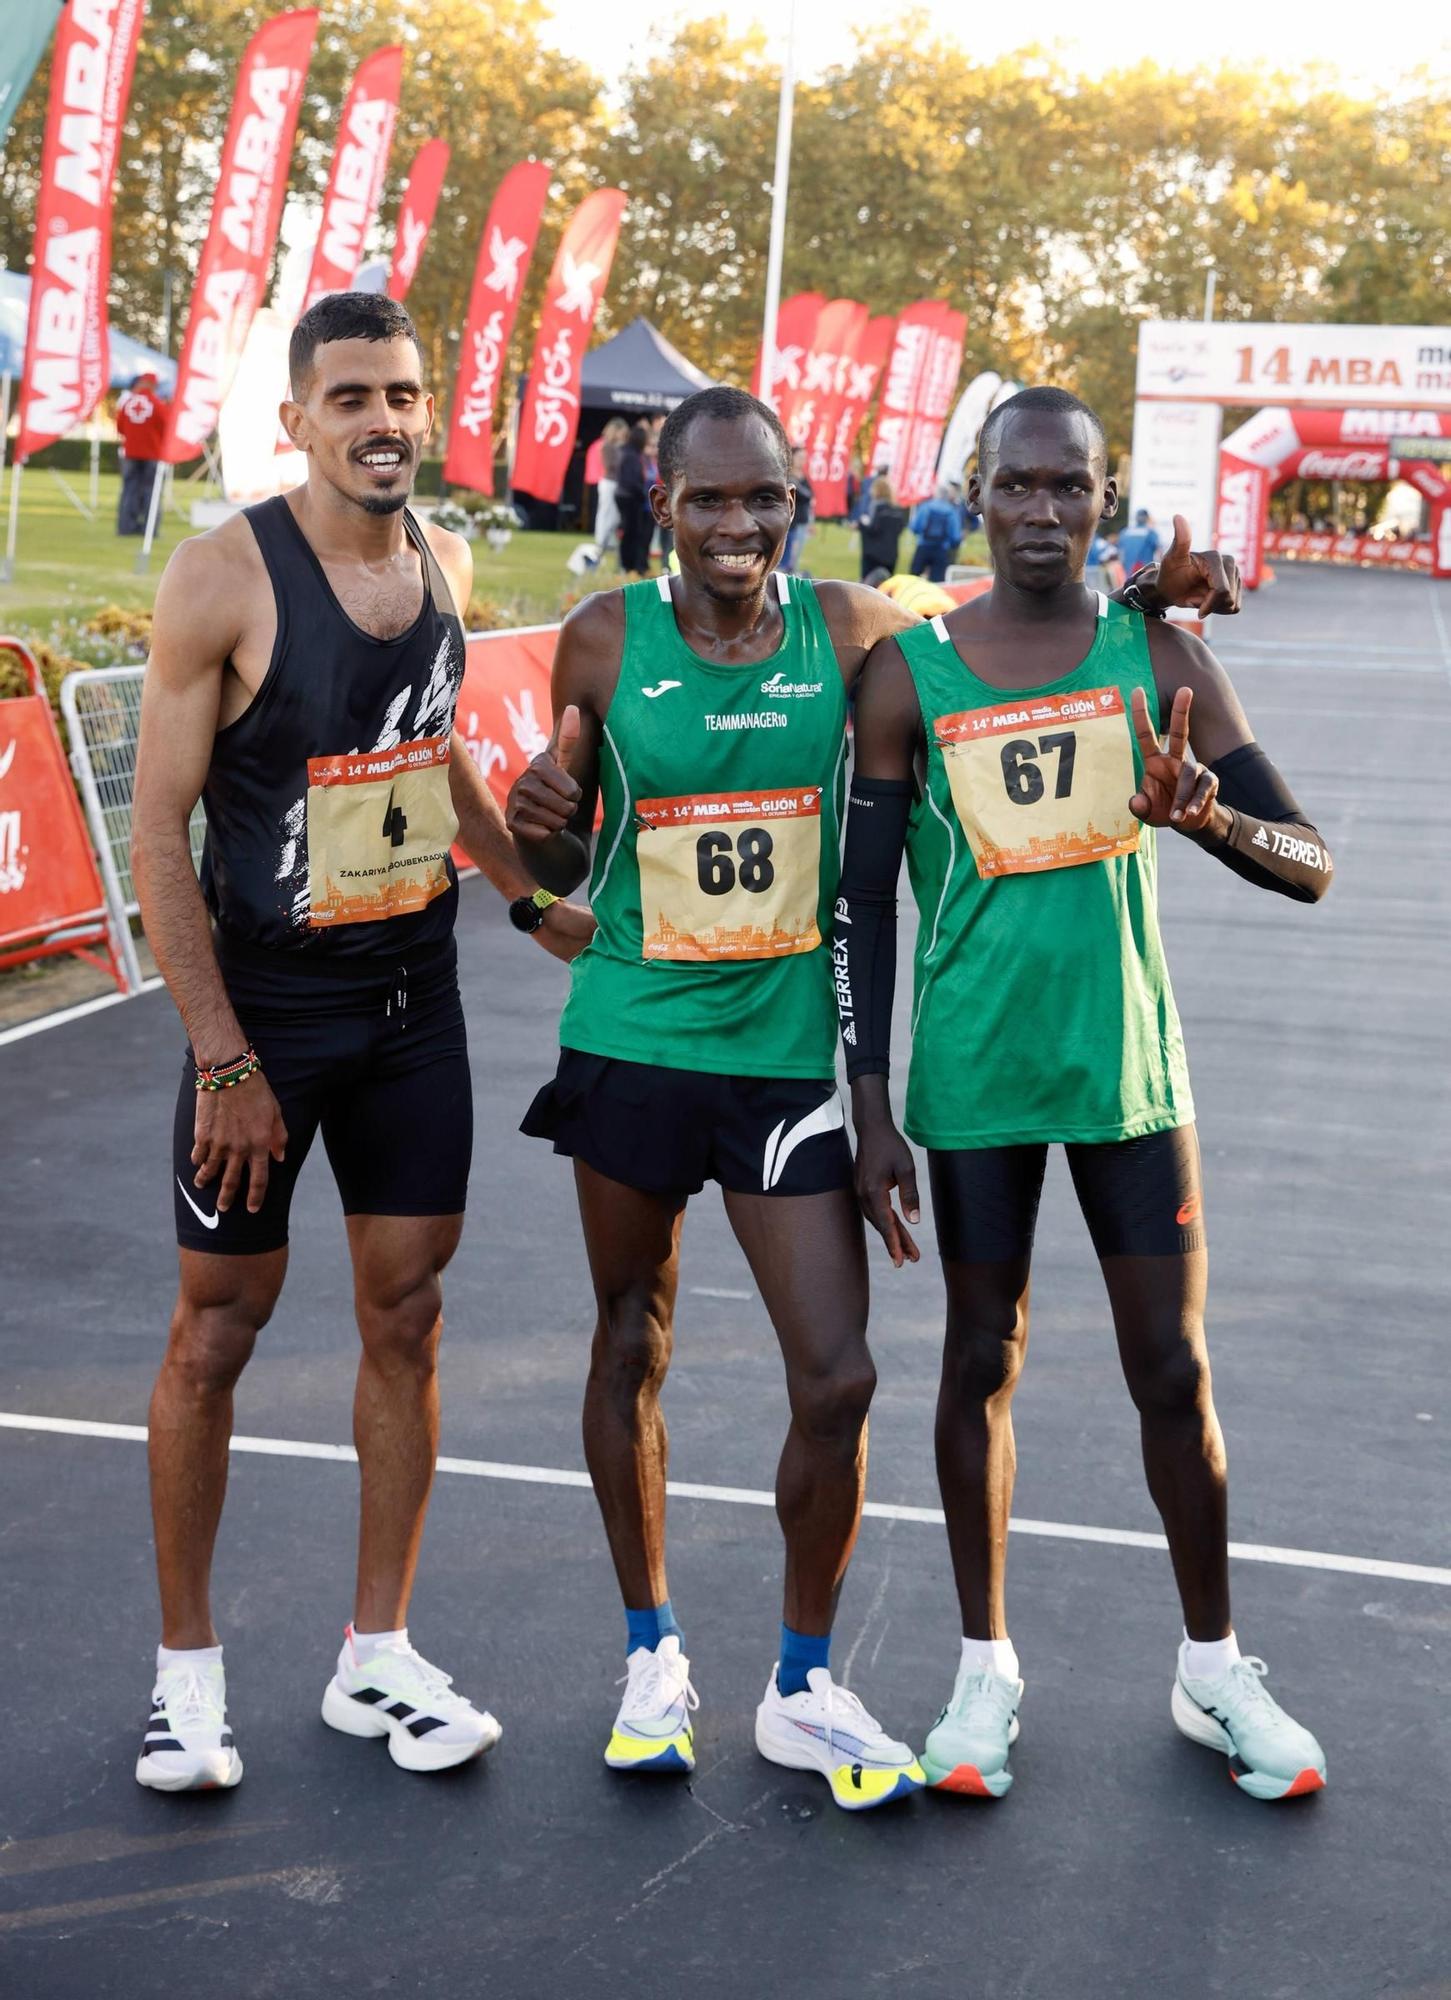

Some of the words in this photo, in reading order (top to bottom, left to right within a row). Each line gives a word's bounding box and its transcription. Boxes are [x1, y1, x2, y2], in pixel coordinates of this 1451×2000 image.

[54, 0, 119, 207] MBA
[222, 67, 290, 253] MBA
[323, 99, 387, 272] MBA
[26, 226, 98, 436] MBA
[176, 269, 247, 444] MBA
[1235, 348, 1291, 384] 14
[1306, 359, 1402, 386] MBA
[1341, 409, 1442, 436] MBA
[1298, 450, 1385, 480] Coca-Cola
[704, 712, 788, 731] TEAMMANAGER10
[992, 711, 1030, 728] MBA
[1060, 700, 1096, 716] GIJÓN
[407, 747, 433, 763] GIJÓN
[1000, 731, 1076, 805] 67
[383, 783, 407, 847] 4
[693, 803, 731, 816] MBA
[761, 797, 797, 811] GIJÓN
[696, 828, 775, 896] 68
[1271, 830, 1323, 871] TERREX
[340, 867, 387, 878] ZAKARIYA
[834, 937, 853, 1020] TERREX
